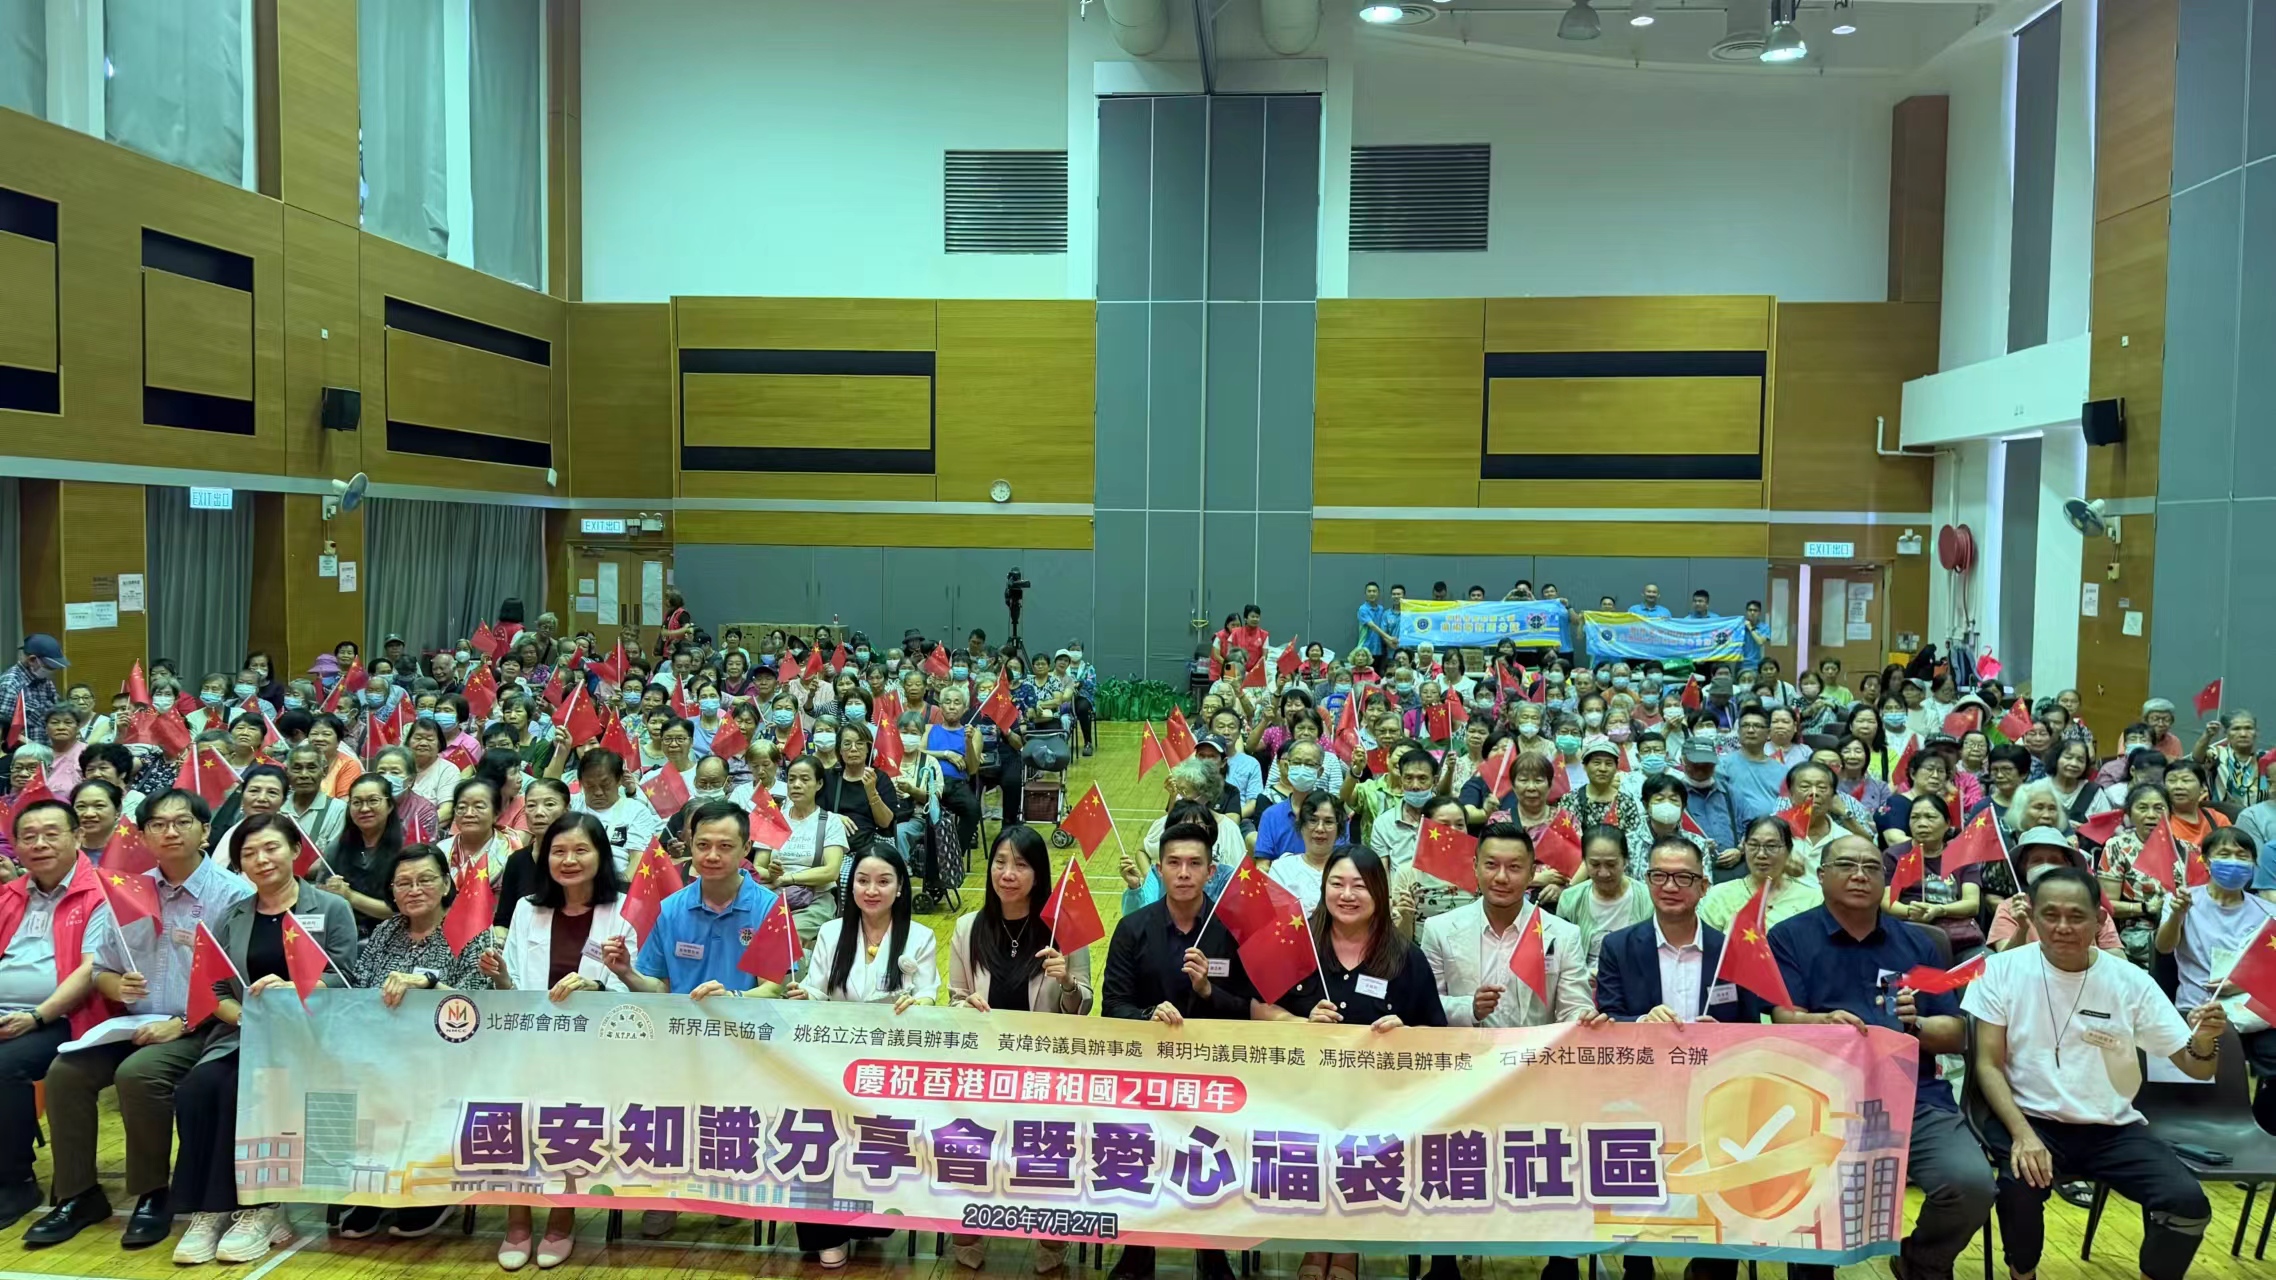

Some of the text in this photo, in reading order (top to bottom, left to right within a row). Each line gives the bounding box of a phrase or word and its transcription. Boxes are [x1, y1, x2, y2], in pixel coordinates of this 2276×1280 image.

[192, 492, 229, 507] EXIT 出口
[584, 520, 622, 531] EXIT 出口
[1809, 543, 1849, 555] EXIT 出口
[486, 1012, 590, 1033] 北部都會商會
[668, 1016, 776, 1042] 新界居民協會
[793, 1023, 979, 1051] 姚銘立法會議員辦事處
[997, 1032, 1143, 1058] 黃煒鈴議員辦事處
[1156, 1040, 1306, 1067] 賴玥均議員辦事處
[1318, 1048, 1473, 1072] 馮振榮議員辦事處
[1668, 1045, 1710, 1067] 合辦
[852, 1063, 1236, 1111] 慶祝香港回歸祖國29周年
[460, 1101, 1662, 1203] 國安知識分享會暨愛心福袋贈社區
[963, 1205, 1118, 1237] 2026年7月27日
